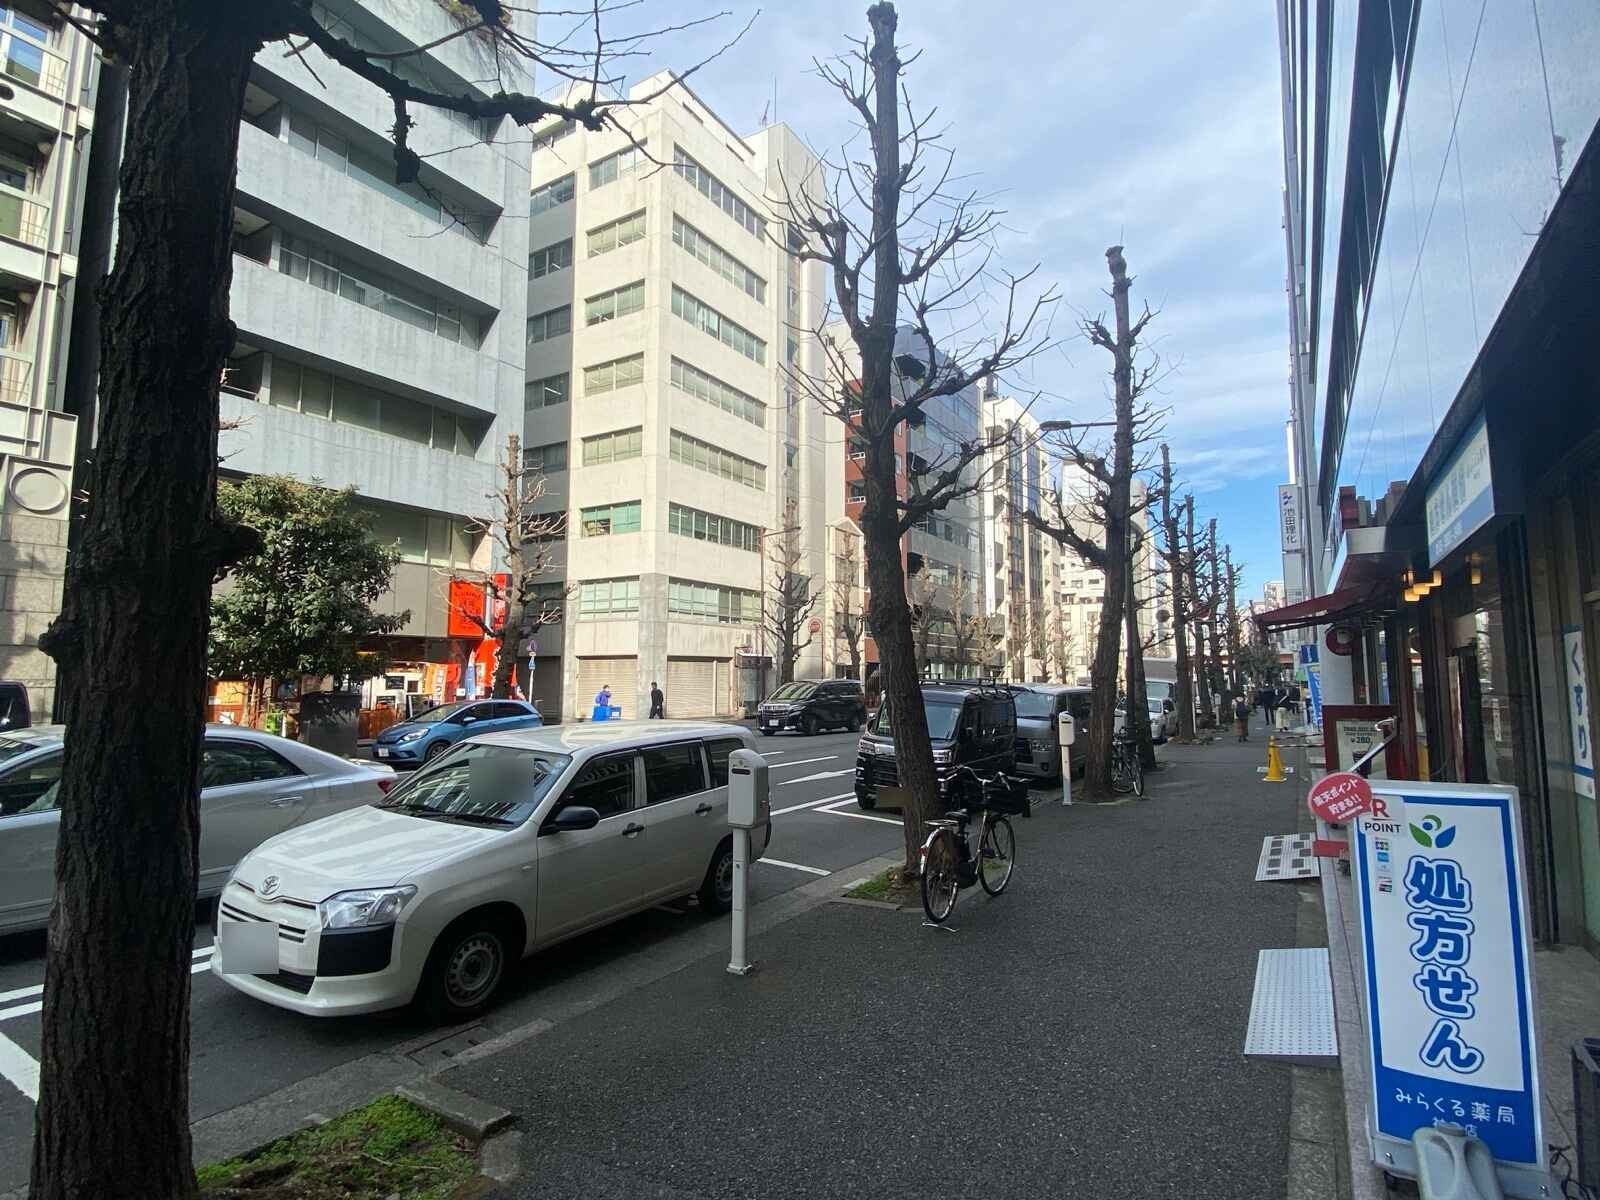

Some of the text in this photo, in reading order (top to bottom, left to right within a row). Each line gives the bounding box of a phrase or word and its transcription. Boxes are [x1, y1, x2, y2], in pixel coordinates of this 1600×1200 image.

[1571, 641, 1588, 760] くすり
[1364, 822, 1401, 833] POINT
[1404, 856, 1484, 1075] 処方せん
[1395, 1087, 1516, 1126] みらくる薬局
